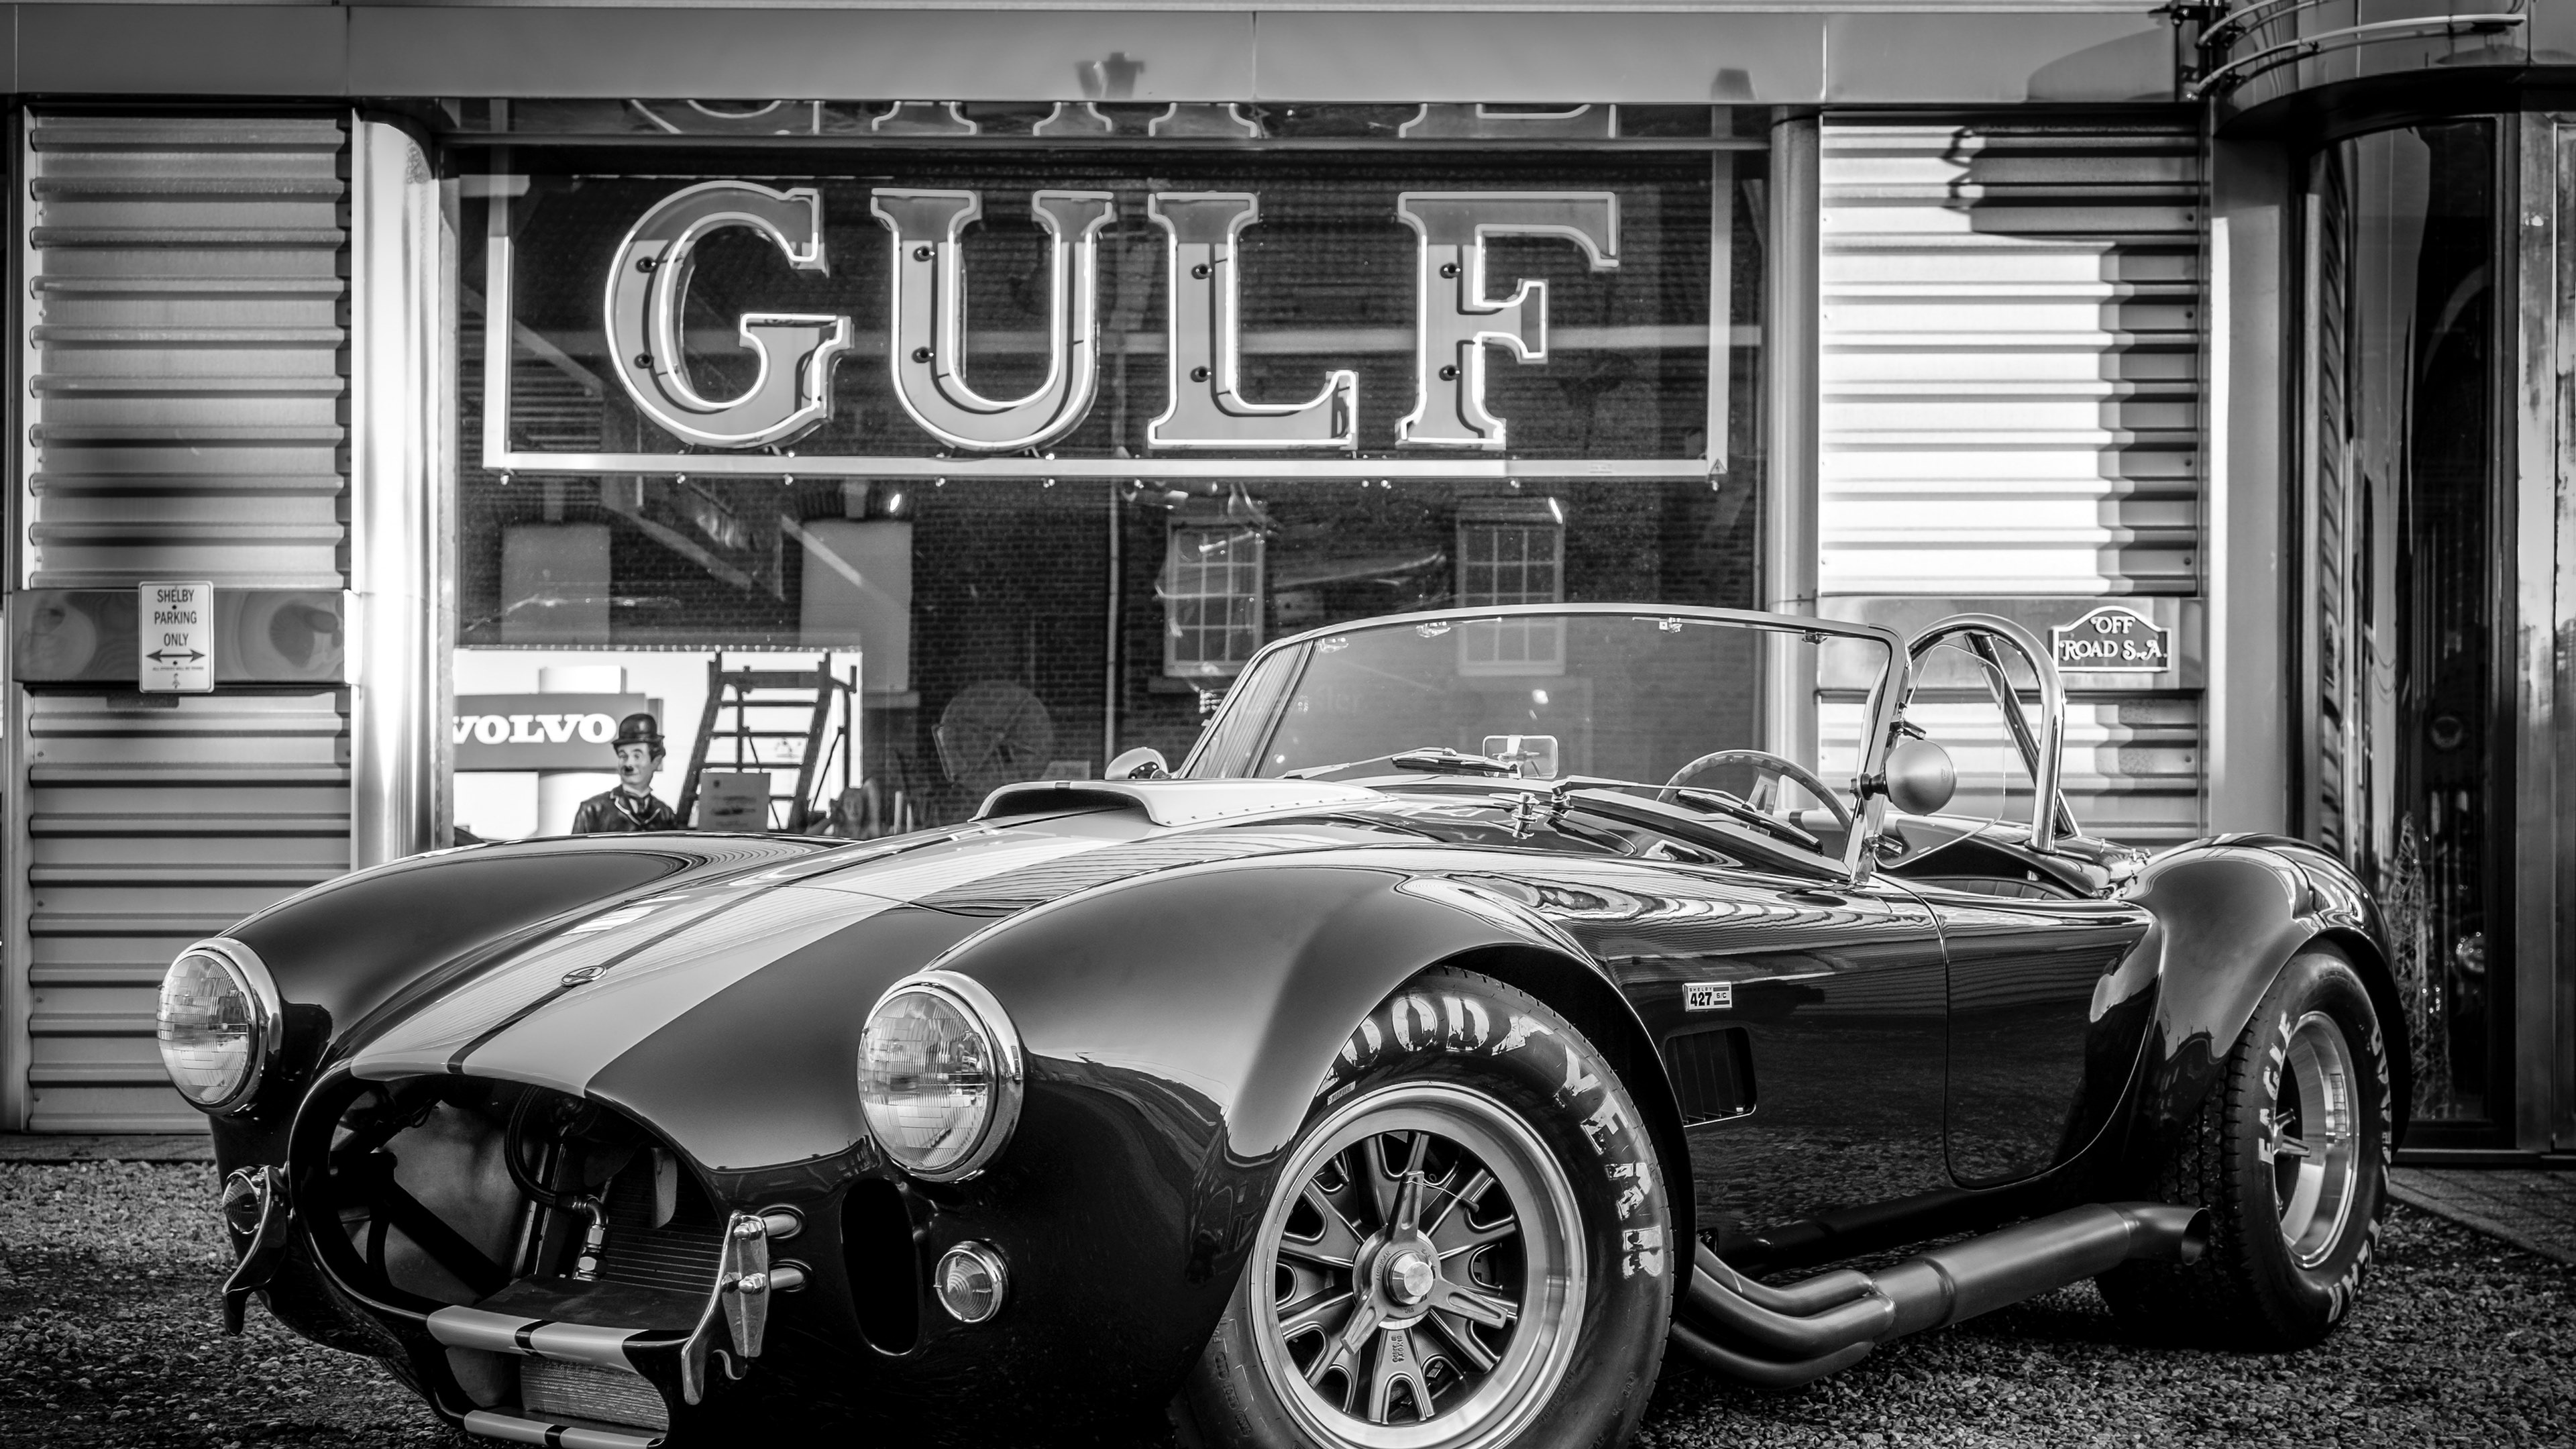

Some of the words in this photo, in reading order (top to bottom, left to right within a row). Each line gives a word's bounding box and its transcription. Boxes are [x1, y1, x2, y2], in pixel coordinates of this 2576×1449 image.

[604, 179, 1620, 449] GULF
[157, 588, 195, 603] SHELBY
[154, 610, 197, 625] PARKING
[2090, 616, 2136, 634] OFF
[164, 633, 189, 647] ONLY
[2059, 640, 2118, 661] ROAD
[452, 713, 617, 745] VOLVO
[1690, 992, 1713, 1006] 427
